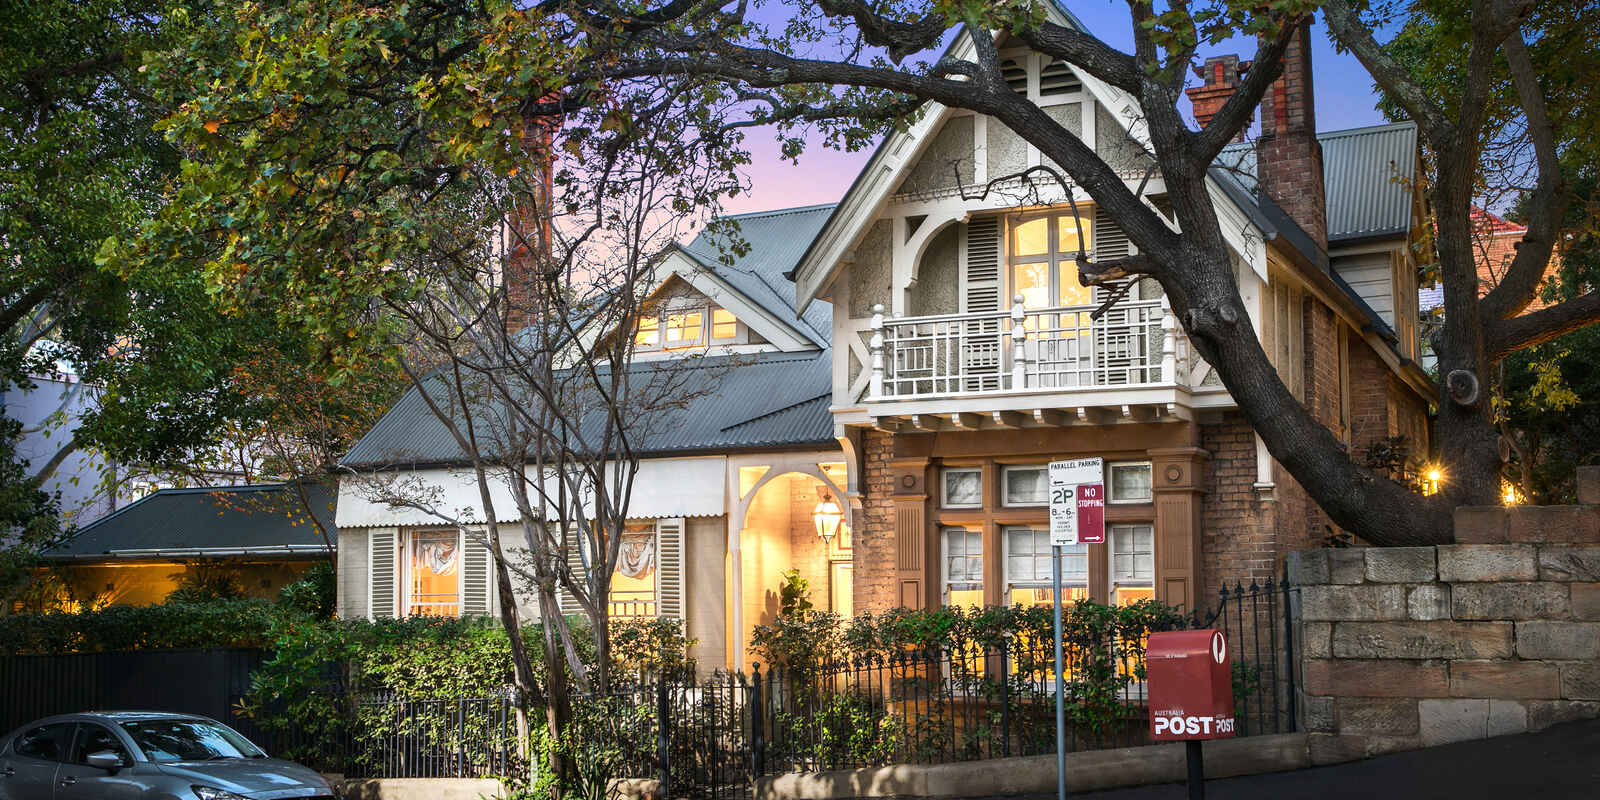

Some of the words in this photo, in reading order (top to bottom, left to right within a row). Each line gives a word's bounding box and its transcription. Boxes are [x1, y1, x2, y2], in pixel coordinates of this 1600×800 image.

[1051, 462, 1076, 470] PARALLEL
[1052, 490, 1074, 504] 2P
[1084, 488, 1096, 497] NO
[1155, 717, 1213, 735] POST
[1216, 718, 1235, 733] POST
